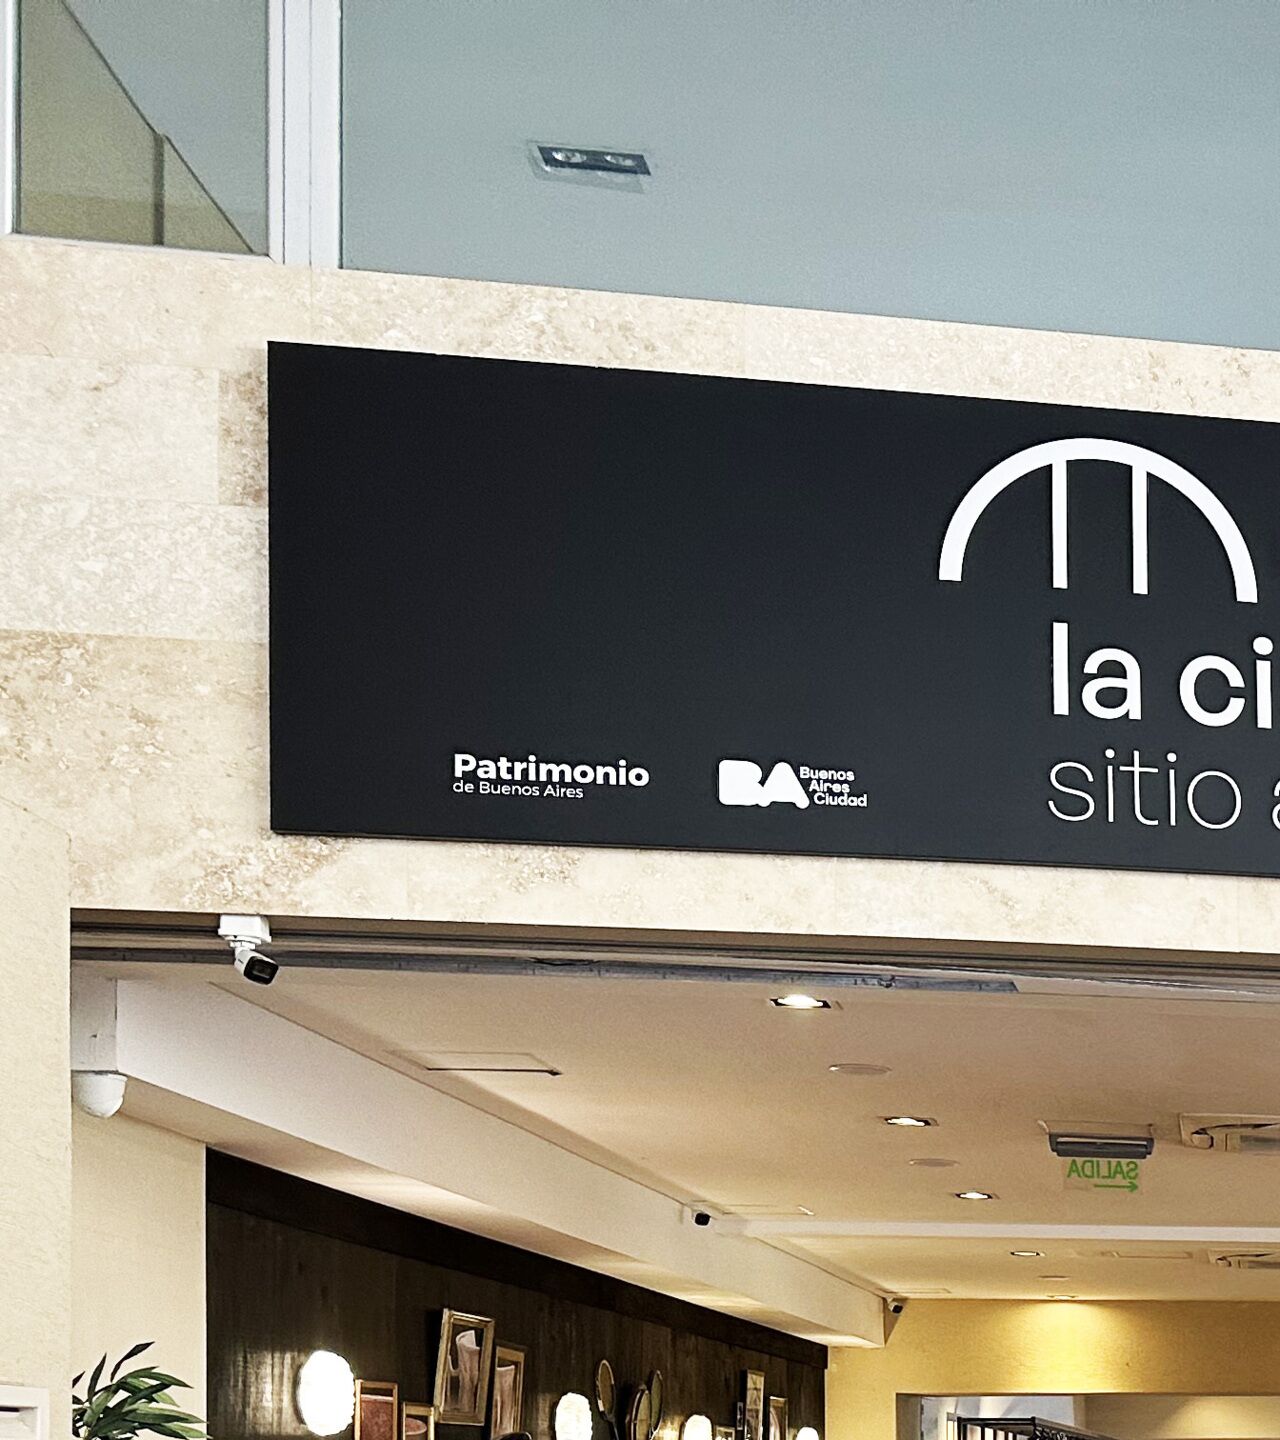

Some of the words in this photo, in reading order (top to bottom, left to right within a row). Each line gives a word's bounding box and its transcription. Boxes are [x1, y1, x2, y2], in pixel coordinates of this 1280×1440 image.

[1052, 621, 1143, 721] la
[454, 753, 650, 787] Patrimonio
[799, 766, 855, 782] Buenos
[452, 780, 475, 794] de
[479, 781, 541, 798] Buenos
[543, 784, 584, 799] Aires
[718, 759, 810, 810] BA
[808, 779, 851, 793] Aires
[1047, 748, 1242, 830] sitio
[813, 791, 868, 807] Ciudad
